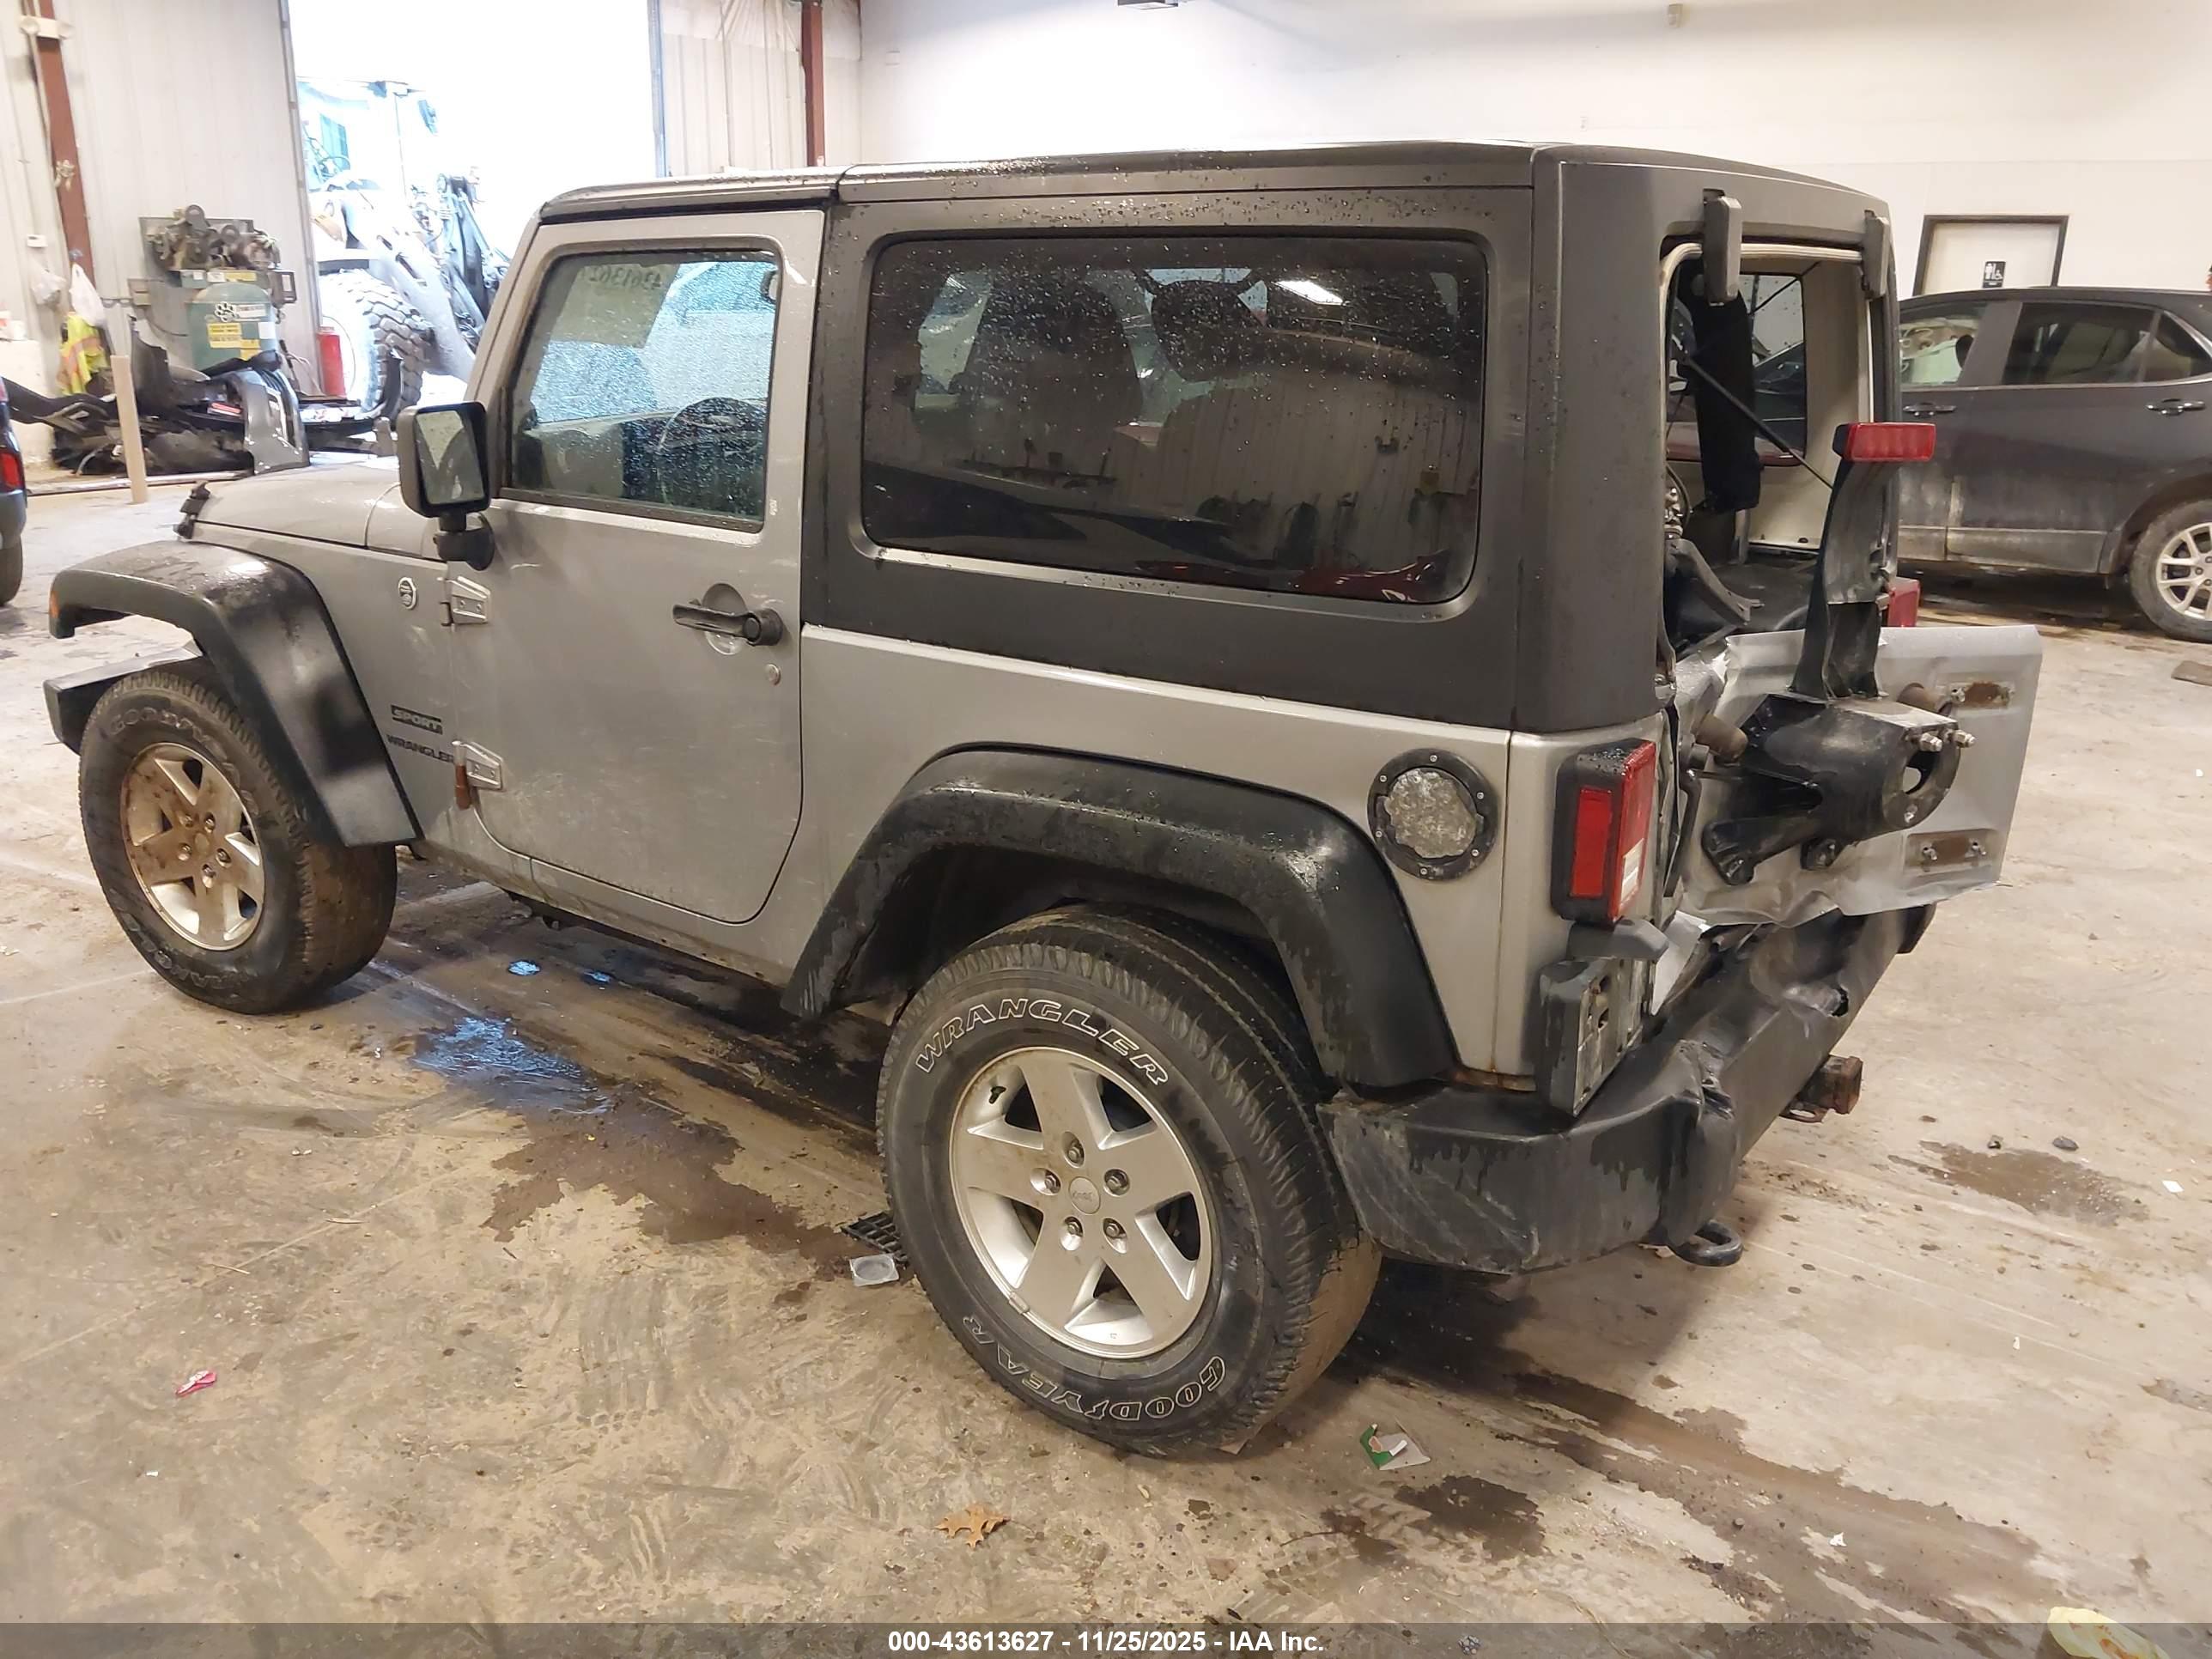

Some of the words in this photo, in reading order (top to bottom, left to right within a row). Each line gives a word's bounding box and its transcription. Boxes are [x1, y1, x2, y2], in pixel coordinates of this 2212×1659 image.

[386, 734, 454, 763] WRANGLER
[392, 708, 442, 733] SPORT
[915, 998, 1170, 1085] WRANGLER
[963, 1316, 1227, 1421] GOODYEAR
